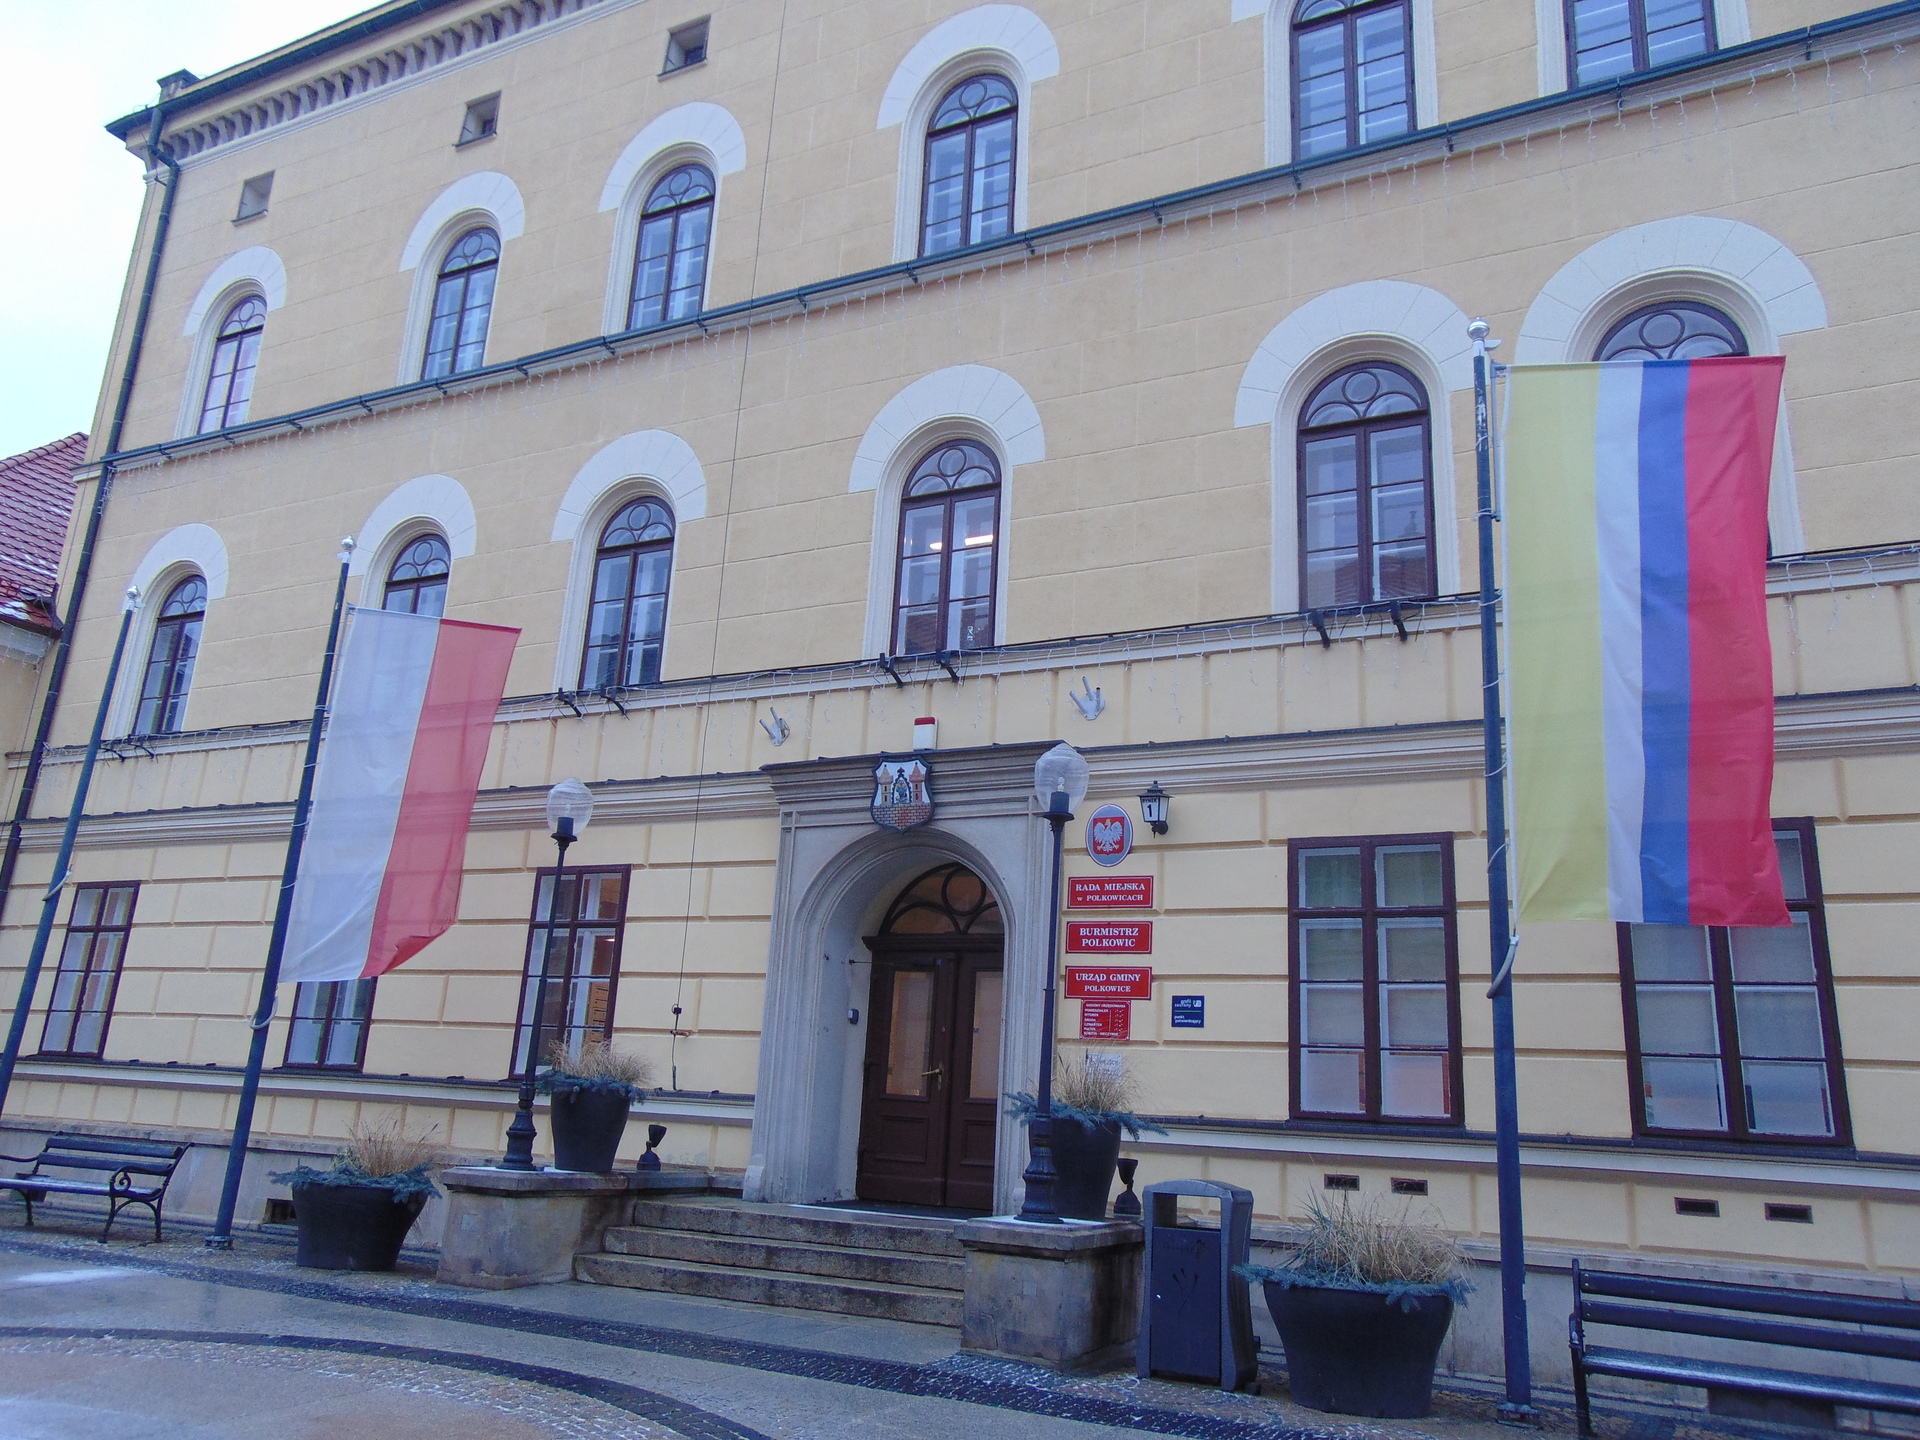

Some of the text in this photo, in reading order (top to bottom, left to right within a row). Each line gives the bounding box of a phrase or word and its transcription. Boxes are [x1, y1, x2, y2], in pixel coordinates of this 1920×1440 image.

[1147, 804, 1152, 817] 1
[1075, 883, 1145, 891] RADA MIEJSKA
[1086, 894, 1143, 902] POLKOWICACH
[1080, 928, 1138, 936] BURMISTRZ
[1075, 973, 1141, 982] URZĄD GMINY
